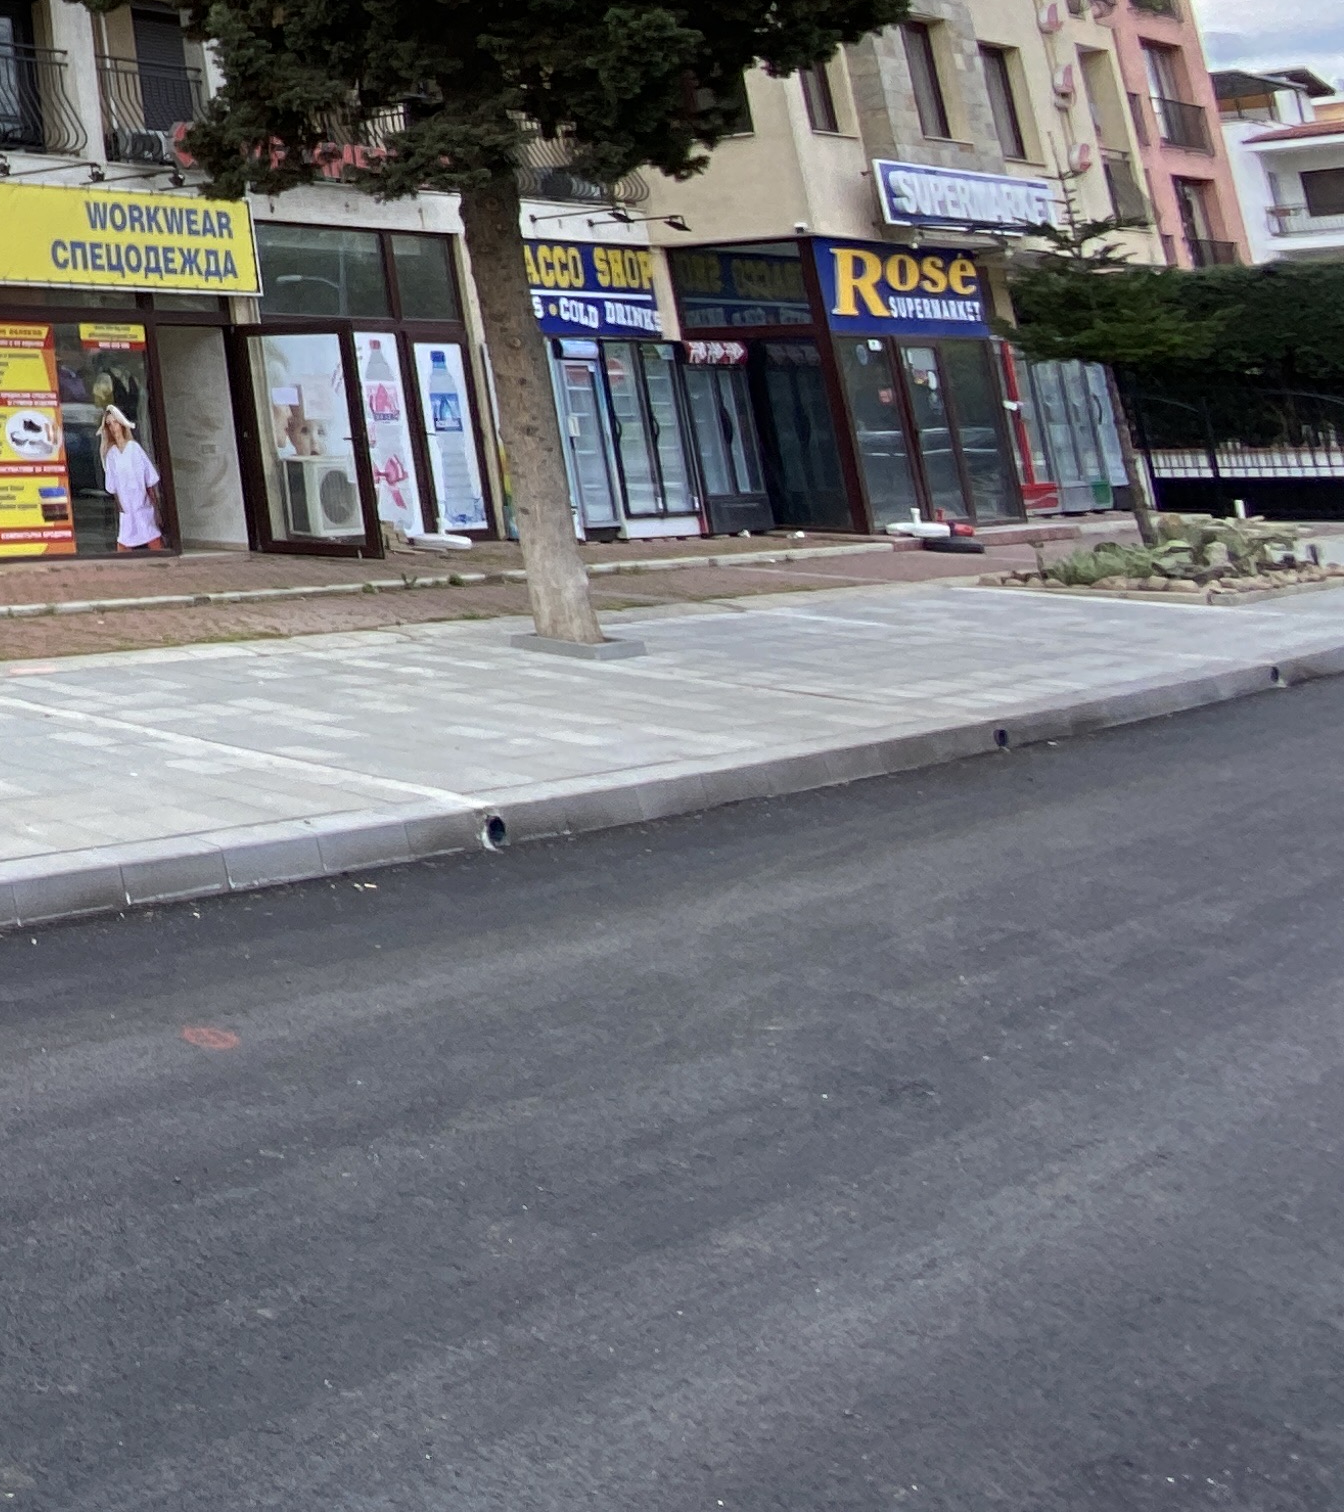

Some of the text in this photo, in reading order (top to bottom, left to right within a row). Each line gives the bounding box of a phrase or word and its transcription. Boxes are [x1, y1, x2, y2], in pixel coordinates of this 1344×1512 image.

[887, 169, 1058, 227] SUPERMARKET
[84, 200, 234, 239] WORKWEAR
[50, 238, 239, 284] СПЕЦОДЕЖДА
[523, 244, 585, 289] ACCO
[593, 246, 654, 289] SHOP
[558, 296, 600, 330] COLD
[603, 300, 663, 333] DRINKS
[888, 295, 982, 322] SUPERMARKET
